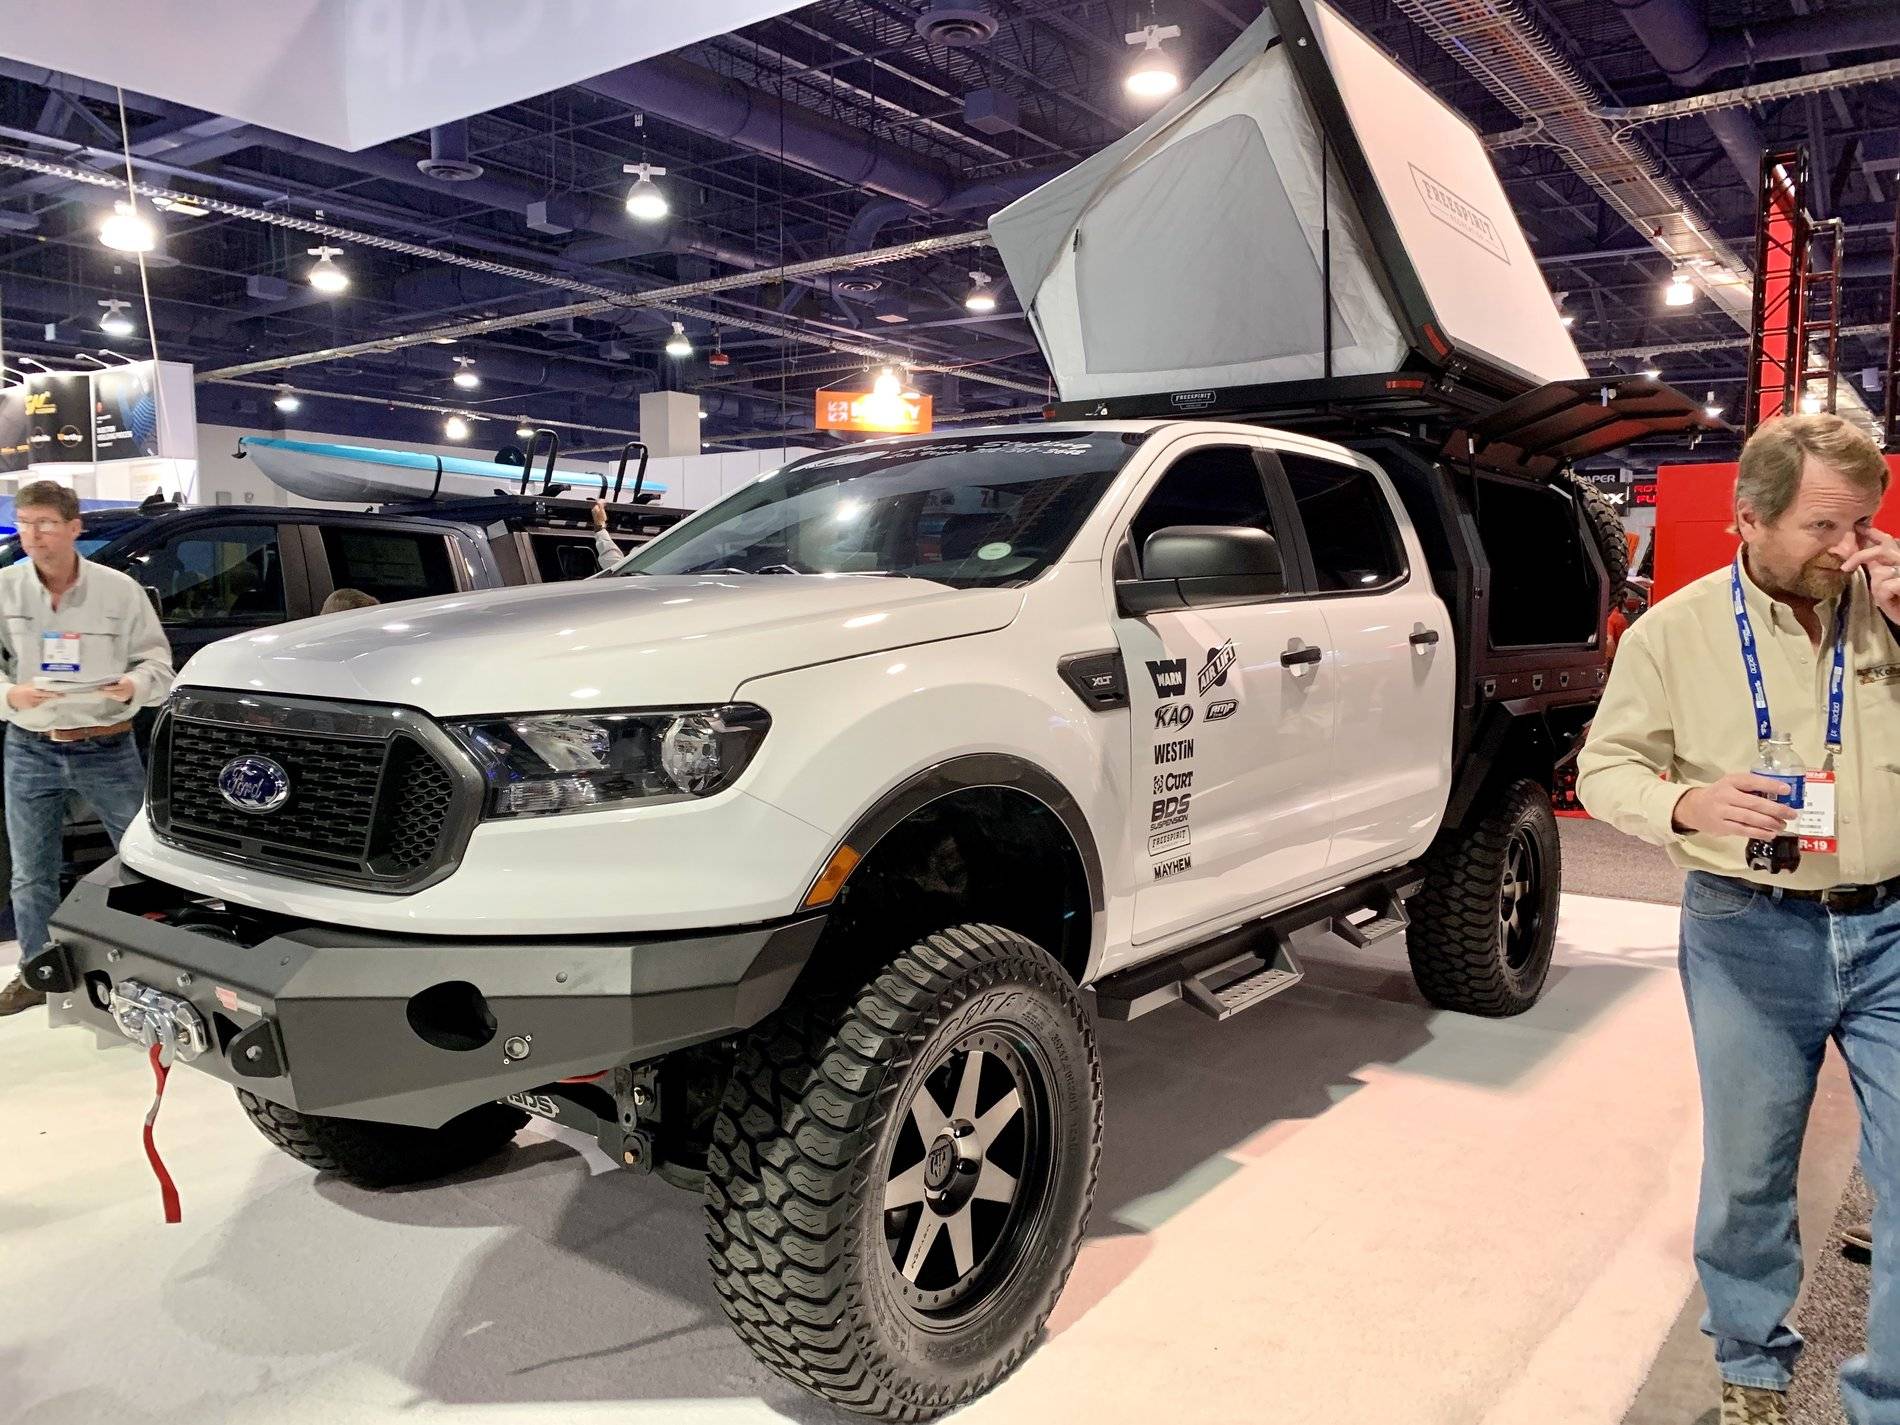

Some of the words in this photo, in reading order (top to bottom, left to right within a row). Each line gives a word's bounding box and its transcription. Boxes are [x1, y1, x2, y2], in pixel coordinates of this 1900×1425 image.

[1200, 664, 1218, 691] AIR
[1215, 644, 1235, 674] LIFT
[1091, 675, 1113, 687] XLT
[1156, 671, 1183, 687] WARN
[1155, 704, 1192, 729] KAO
[1151, 793, 1192, 822] BDS
[1150, 814, 1188, 831] SUSPENSION
[1152, 829, 1186, 848] FREESPIRIT
[1154, 856, 1192, 880] MAYHEM
